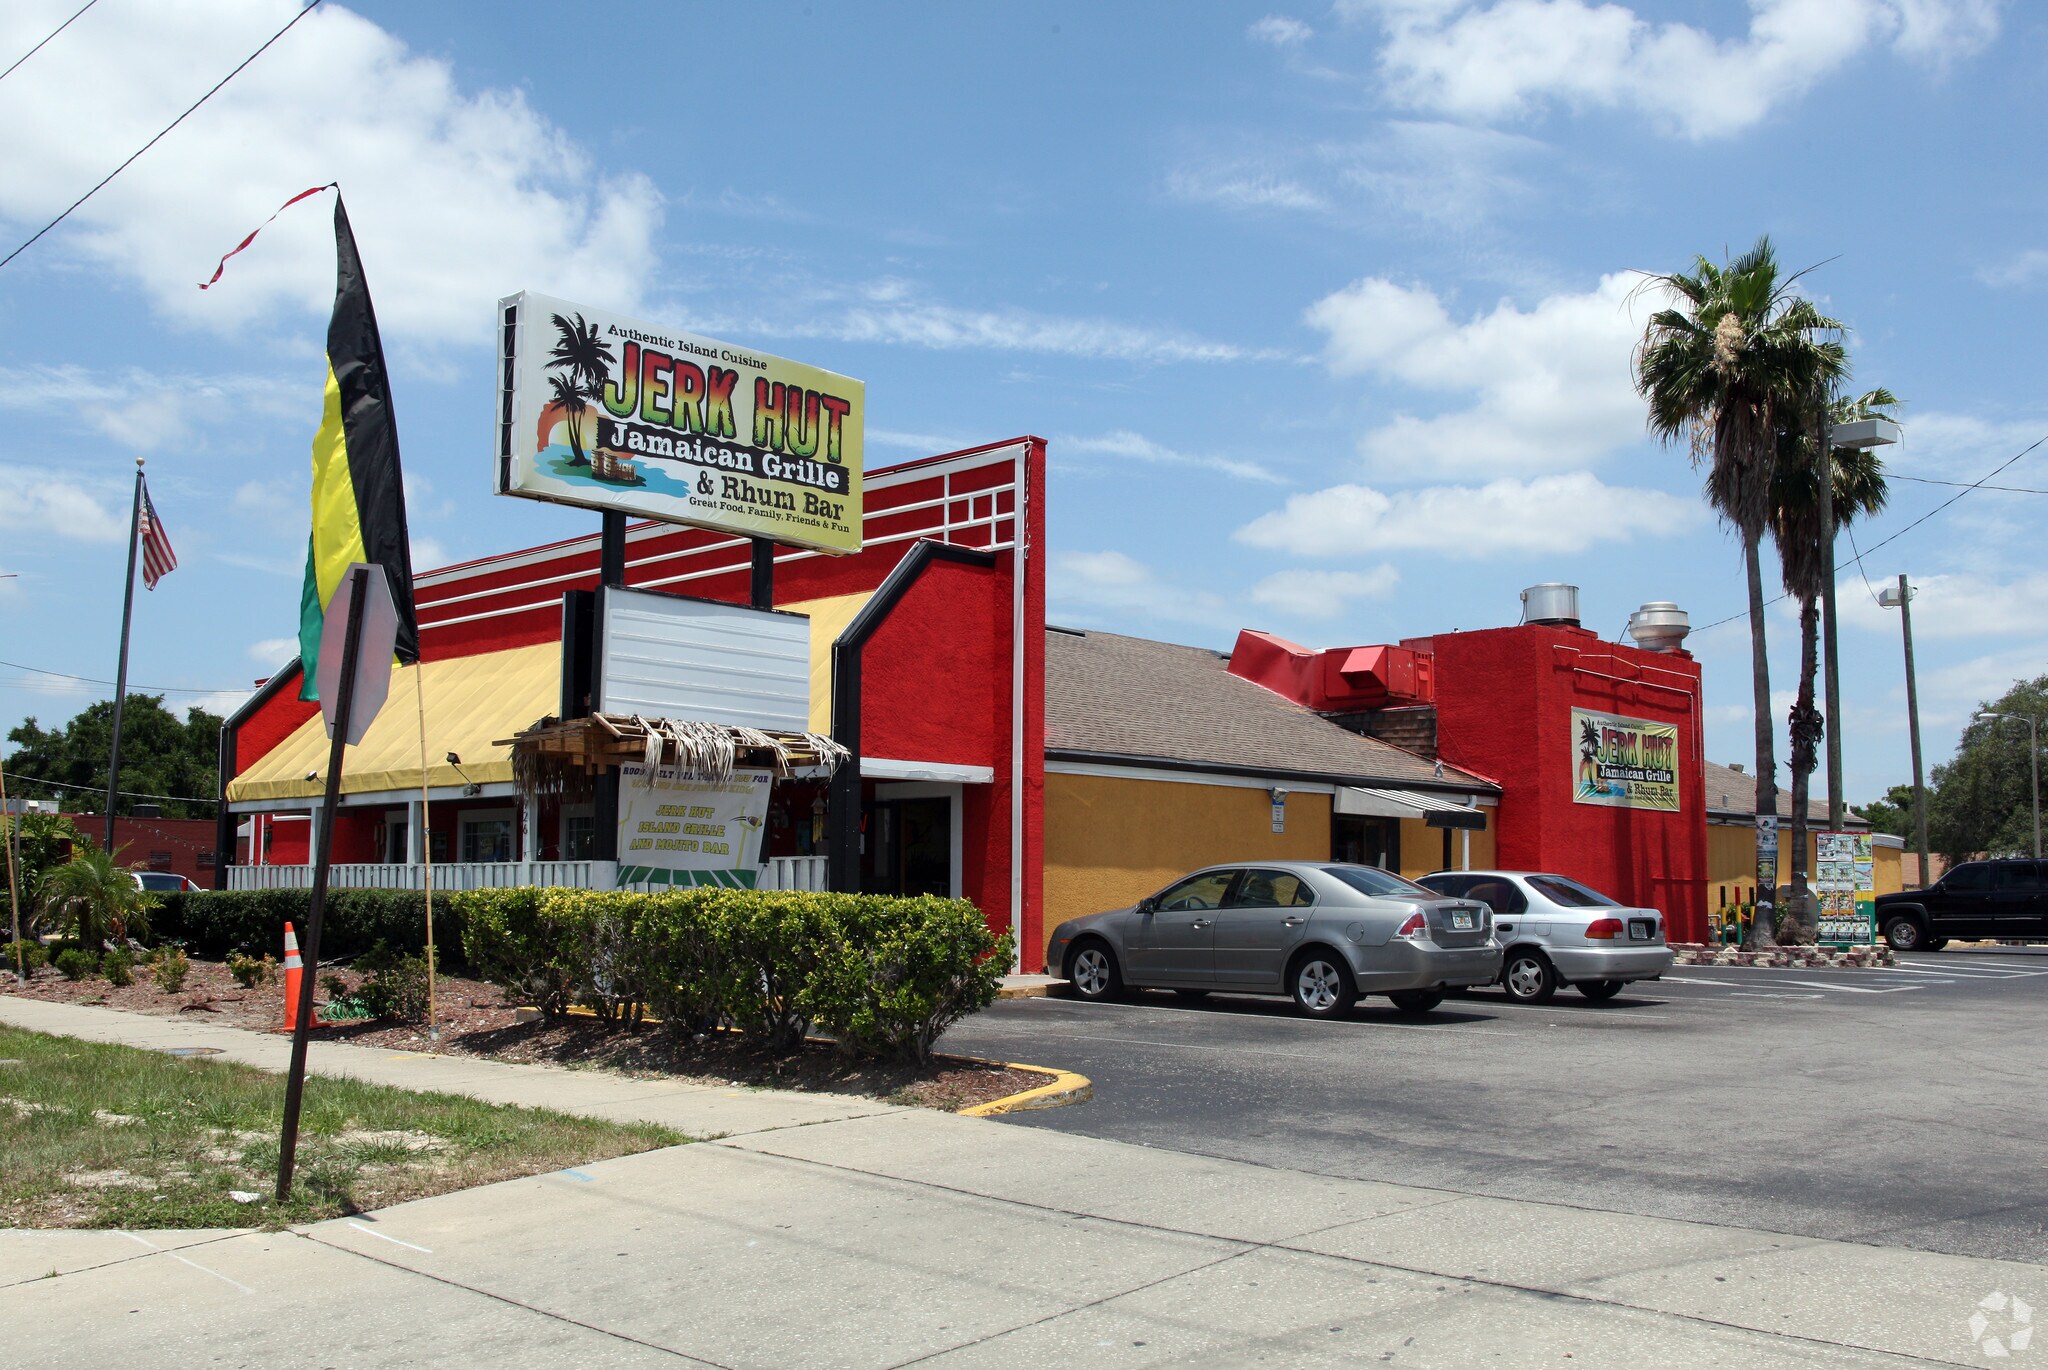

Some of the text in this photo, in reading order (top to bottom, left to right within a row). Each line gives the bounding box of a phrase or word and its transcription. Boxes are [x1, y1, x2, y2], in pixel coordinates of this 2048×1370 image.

[608, 324, 768, 370] Authentic Island Cuisine
[602, 340, 850, 464] JERK HUT
[611, 423, 840, 489] Jamaican Grille
[696, 470, 844, 521] & Rhum Bar
[689, 496, 850, 534] Great Food, Family, Friends & Fun
[1597, 726, 1674, 769] JERK HUT
[752, 774, 769, 784] FOR
[1600, 766, 1672, 782] Jamaican Grille
[1627, 782, 1632, 793] &
[1634, 783, 1658, 796] Rhum
[656, 804, 715, 818] JERK HUT
[637, 821, 726, 837] ISLAND GRILLE
[629, 838, 729, 854] AND MOJITO BAR
